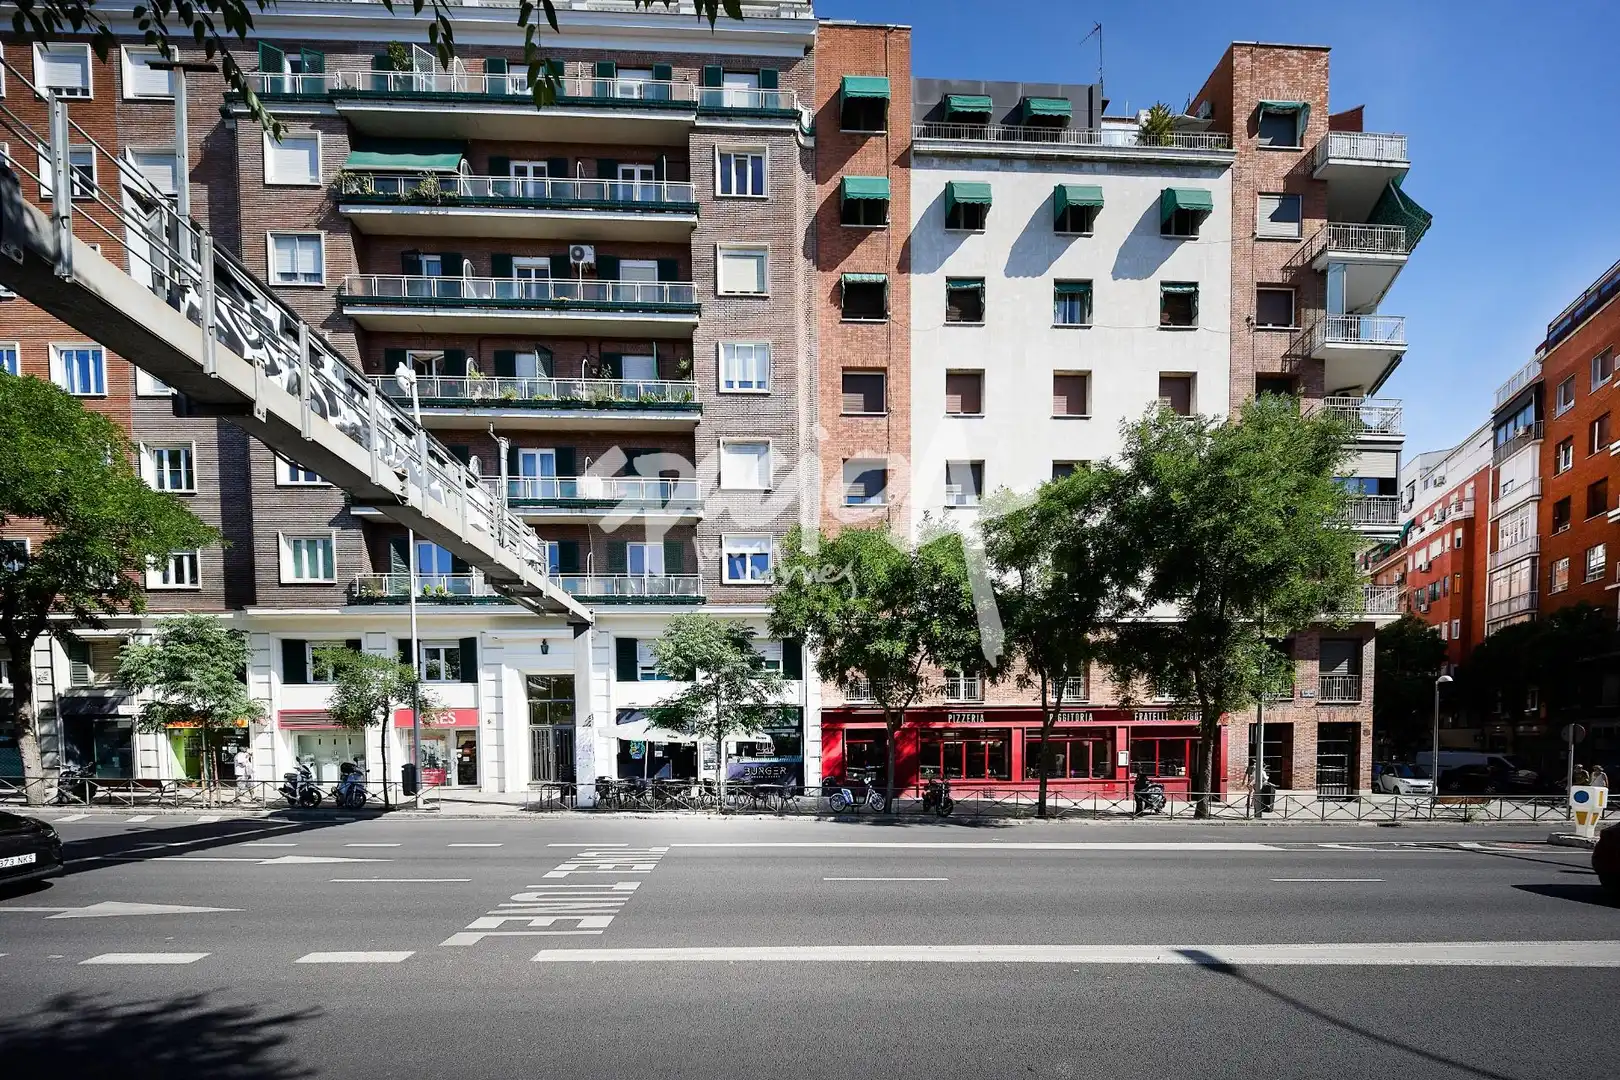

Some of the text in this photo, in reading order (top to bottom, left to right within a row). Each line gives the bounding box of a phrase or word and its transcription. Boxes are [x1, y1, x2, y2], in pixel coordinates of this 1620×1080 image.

[947, 713, 985, 723] PIZZERIA
[744, 766, 787, 776] BURGER
[438, 881, 642, 946] TUNEL
